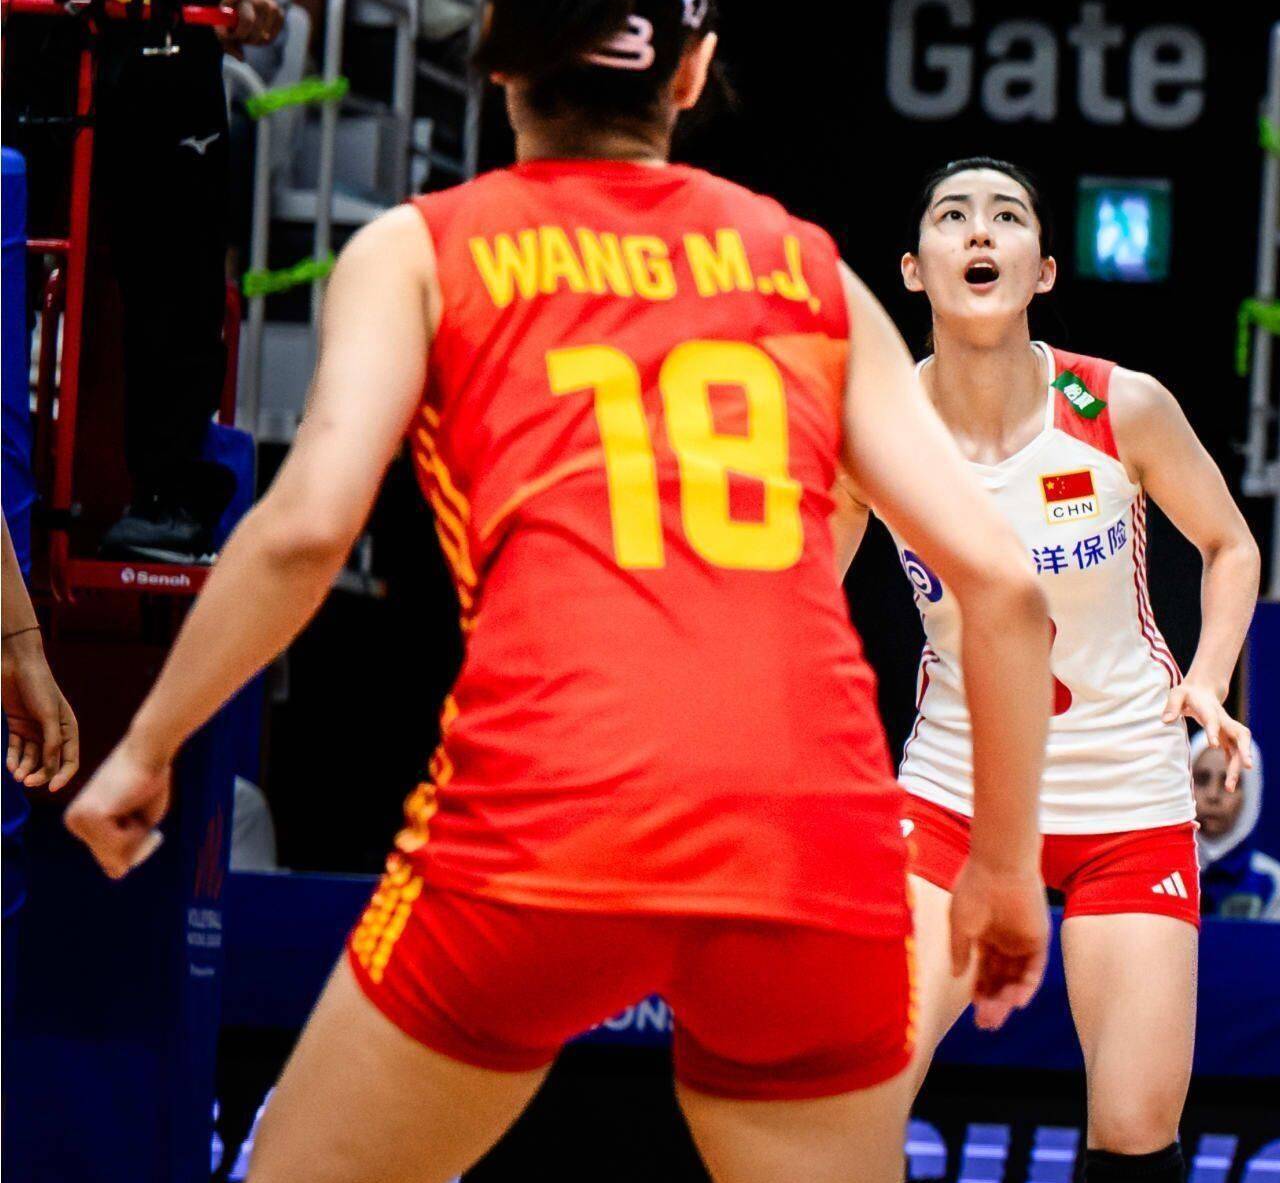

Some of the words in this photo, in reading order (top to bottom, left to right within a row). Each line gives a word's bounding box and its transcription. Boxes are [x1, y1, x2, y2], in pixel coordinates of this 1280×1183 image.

[469, 226, 678, 309] WANG
[544, 338, 805, 572] 18
[1052, 501, 1094, 519] CHN
[1031, 519, 1129, 576] 洋保险
